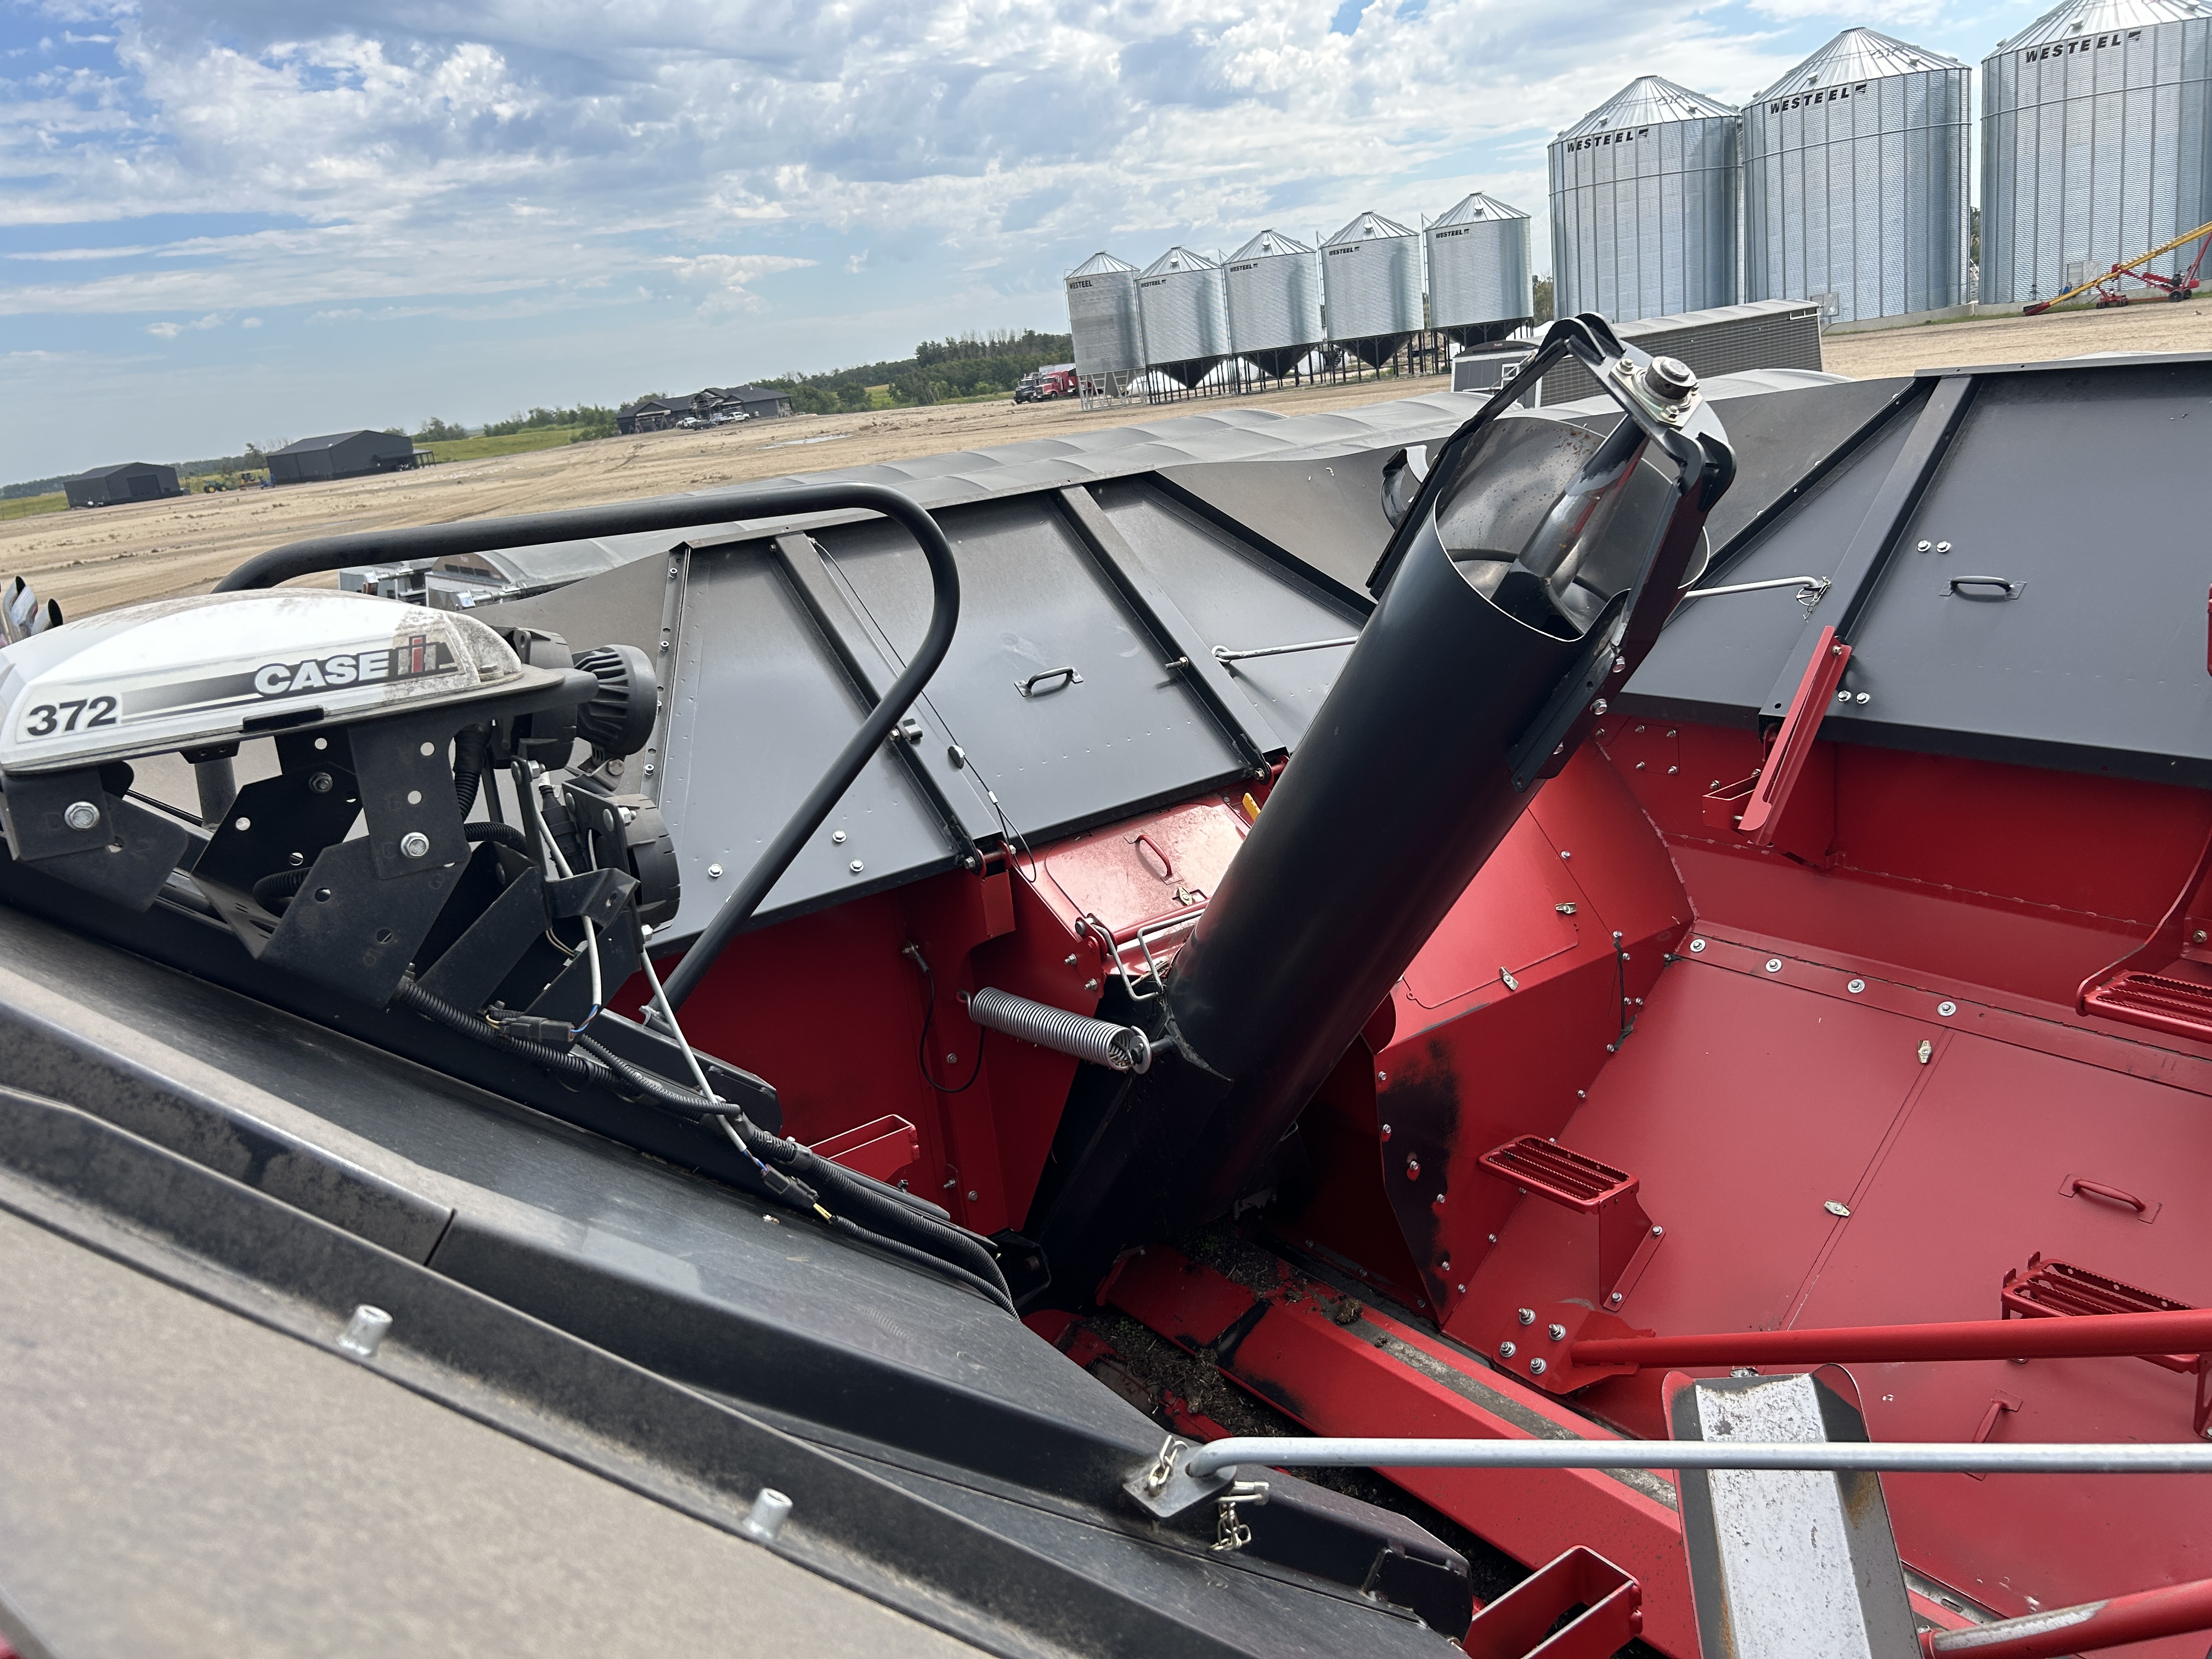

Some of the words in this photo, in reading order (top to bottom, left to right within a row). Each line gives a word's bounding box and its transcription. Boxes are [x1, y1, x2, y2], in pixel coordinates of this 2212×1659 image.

[2025, 34, 2121, 63] WESTEEL
[1770, 88, 1849, 114] WESTEEL
[1567, 131, 1633, 153] WESTEEL
[1435, 229, 1463, 239] WESTEEL
[1329, 247, 1354, 256] WESTEEL
[1229, 264, 1252, 273] WESTEEL
[1069, 280, 1093, 289] WESTEEL
[255, 650, 390, 695] CASE
[27, 695, 117, 736] 372
